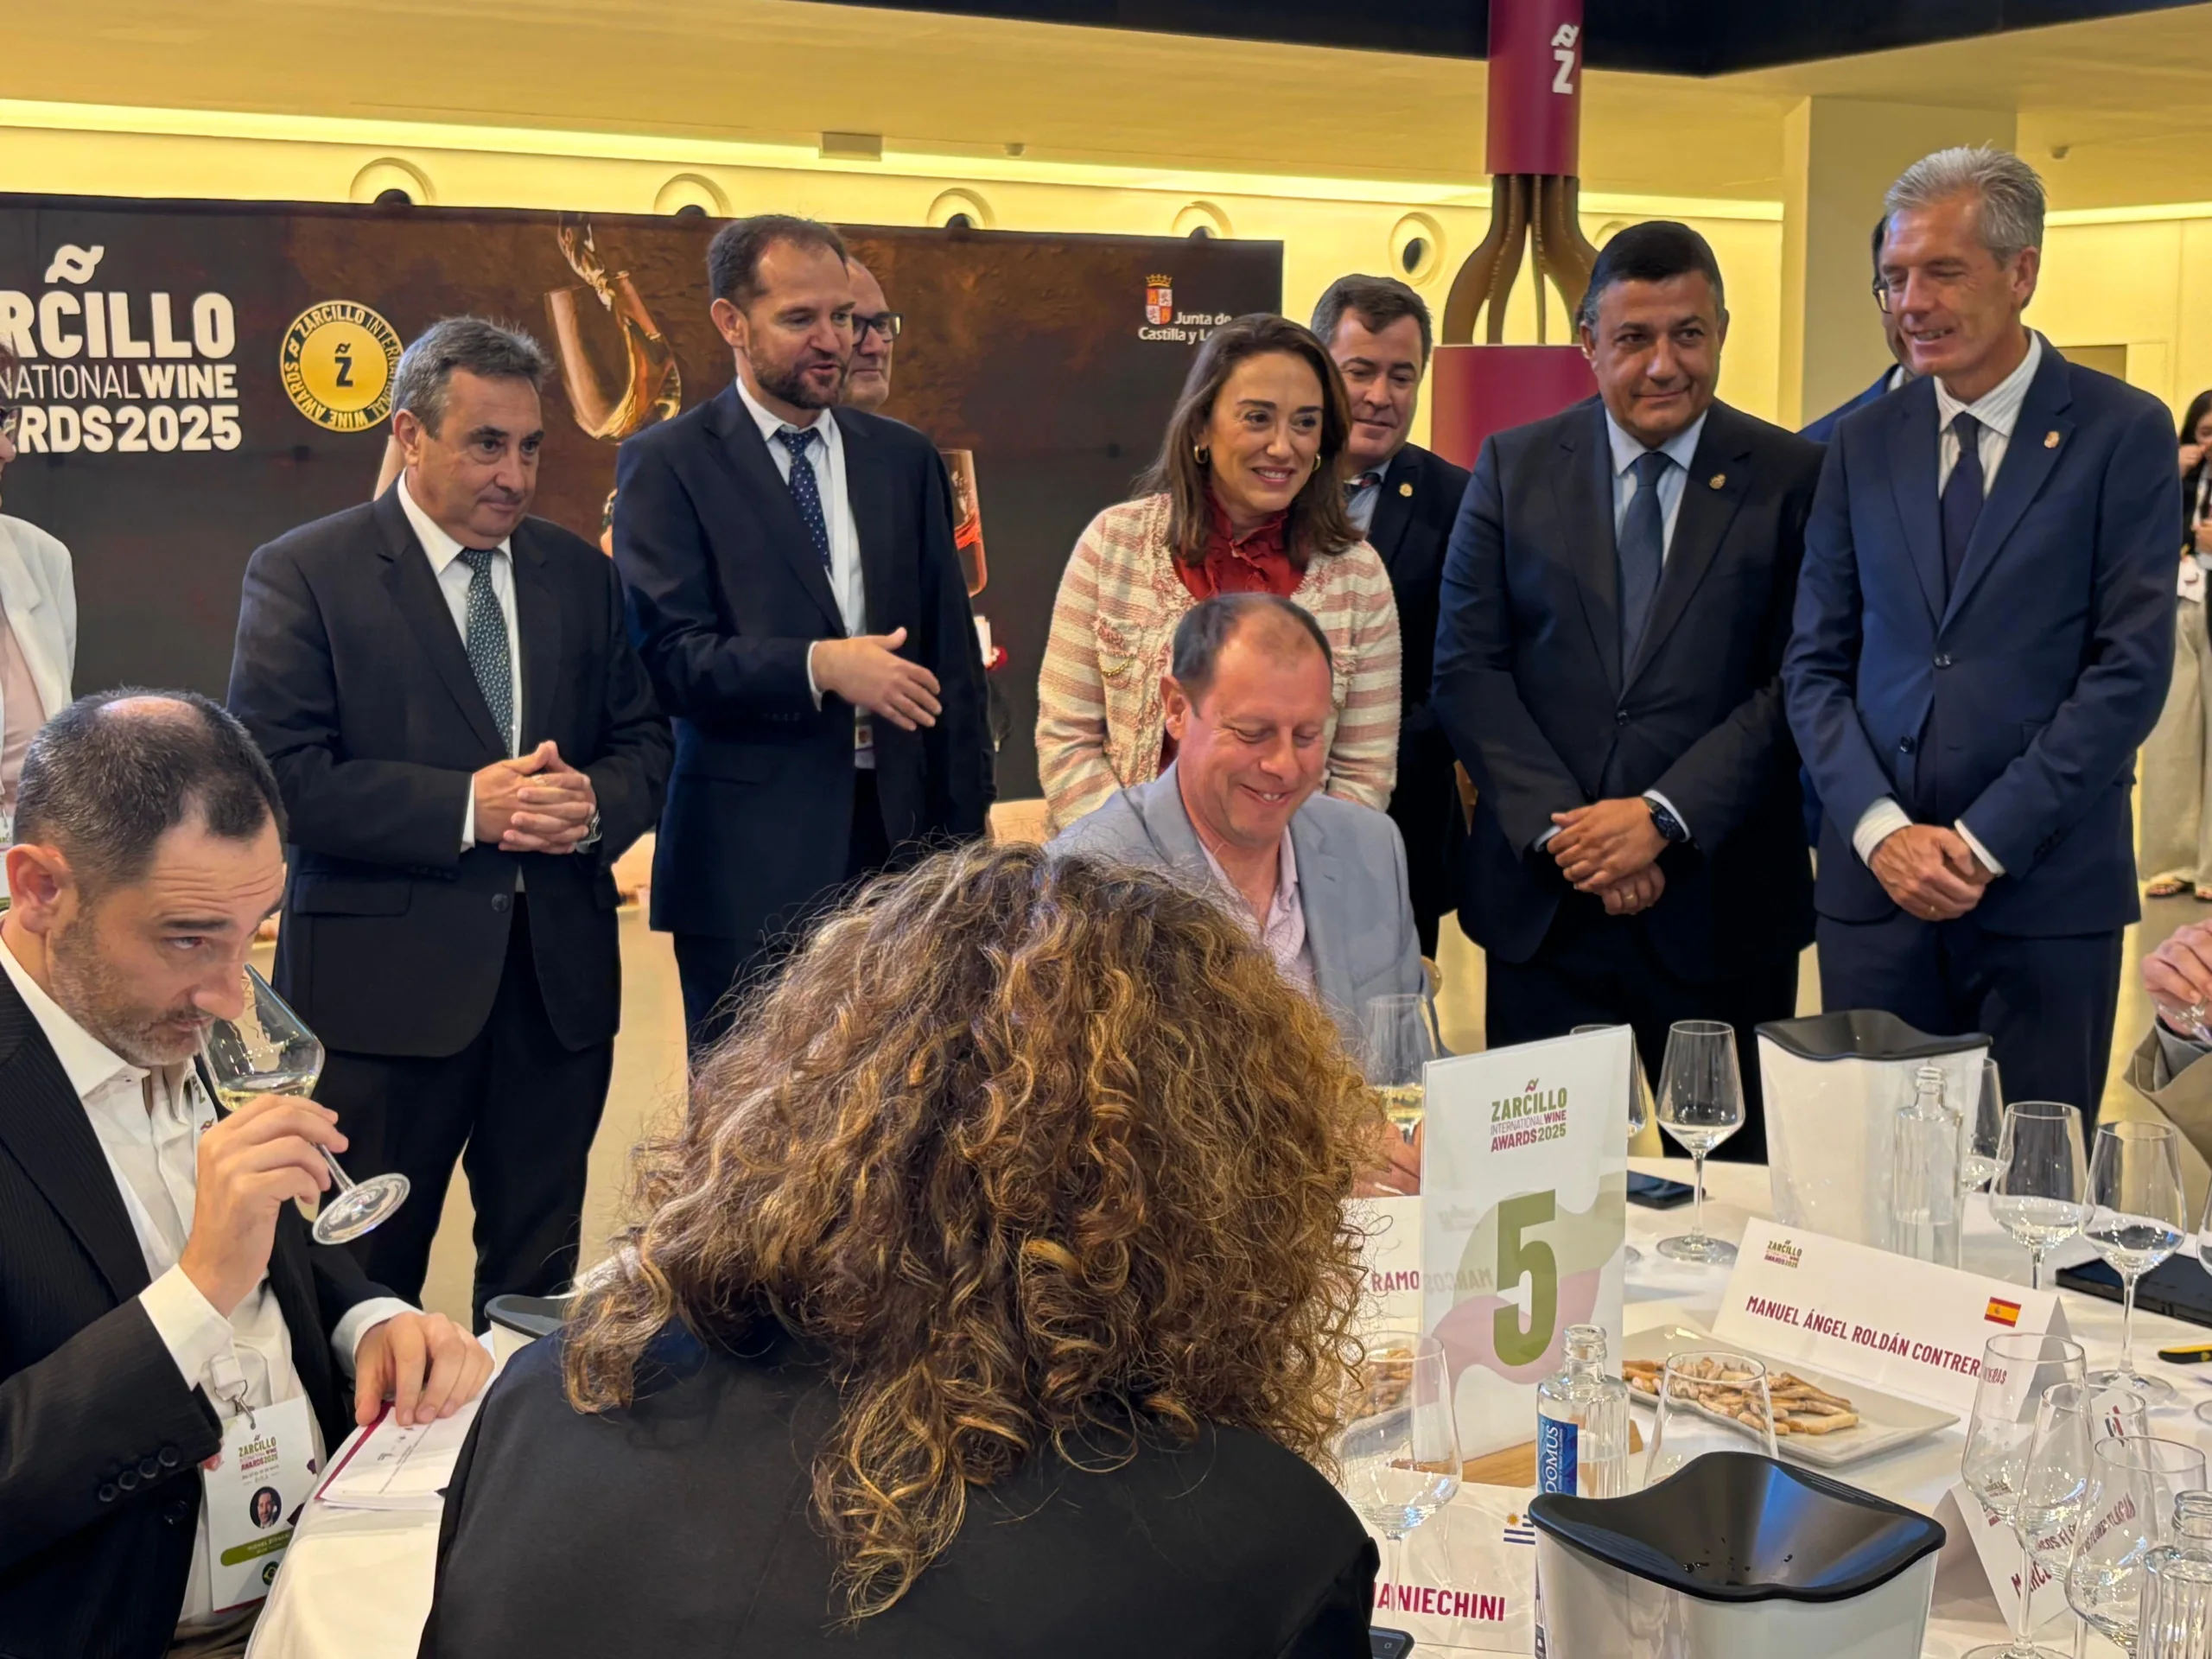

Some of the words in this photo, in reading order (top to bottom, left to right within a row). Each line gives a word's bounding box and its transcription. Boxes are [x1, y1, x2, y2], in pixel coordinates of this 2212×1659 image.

[295, 304, 365, 339] ZARCILLO
[1138, 327, 1186, 341] Castilla
[1186, 331, 1198, 345] y
[1174, 312, 1212, 325] Junta
[284, 361, 327, 422] AWARDS
[327, 410, 369, 429] WINE
[1491, 1087, 1567, 1122] ZARCILLO
[1371, 1270, 1420, 1292] RAMO
[1493, 1188, 1558, 1366] 5
[1745, 1295, 1799, 1326] MANUEL
[1803, 1308, 1847, 1340] ÁNGEL
[1851, 1325, 1910, 1357] ROLDÁN
[1911, 1342, 1981, 1377] CONTRER
[238, 1436, 277, 1458] ZARCILLO
[1545, 1425, 1559, 1493] DOMUS
[1373, 1581, 1505, 1622] ANIECHINI
